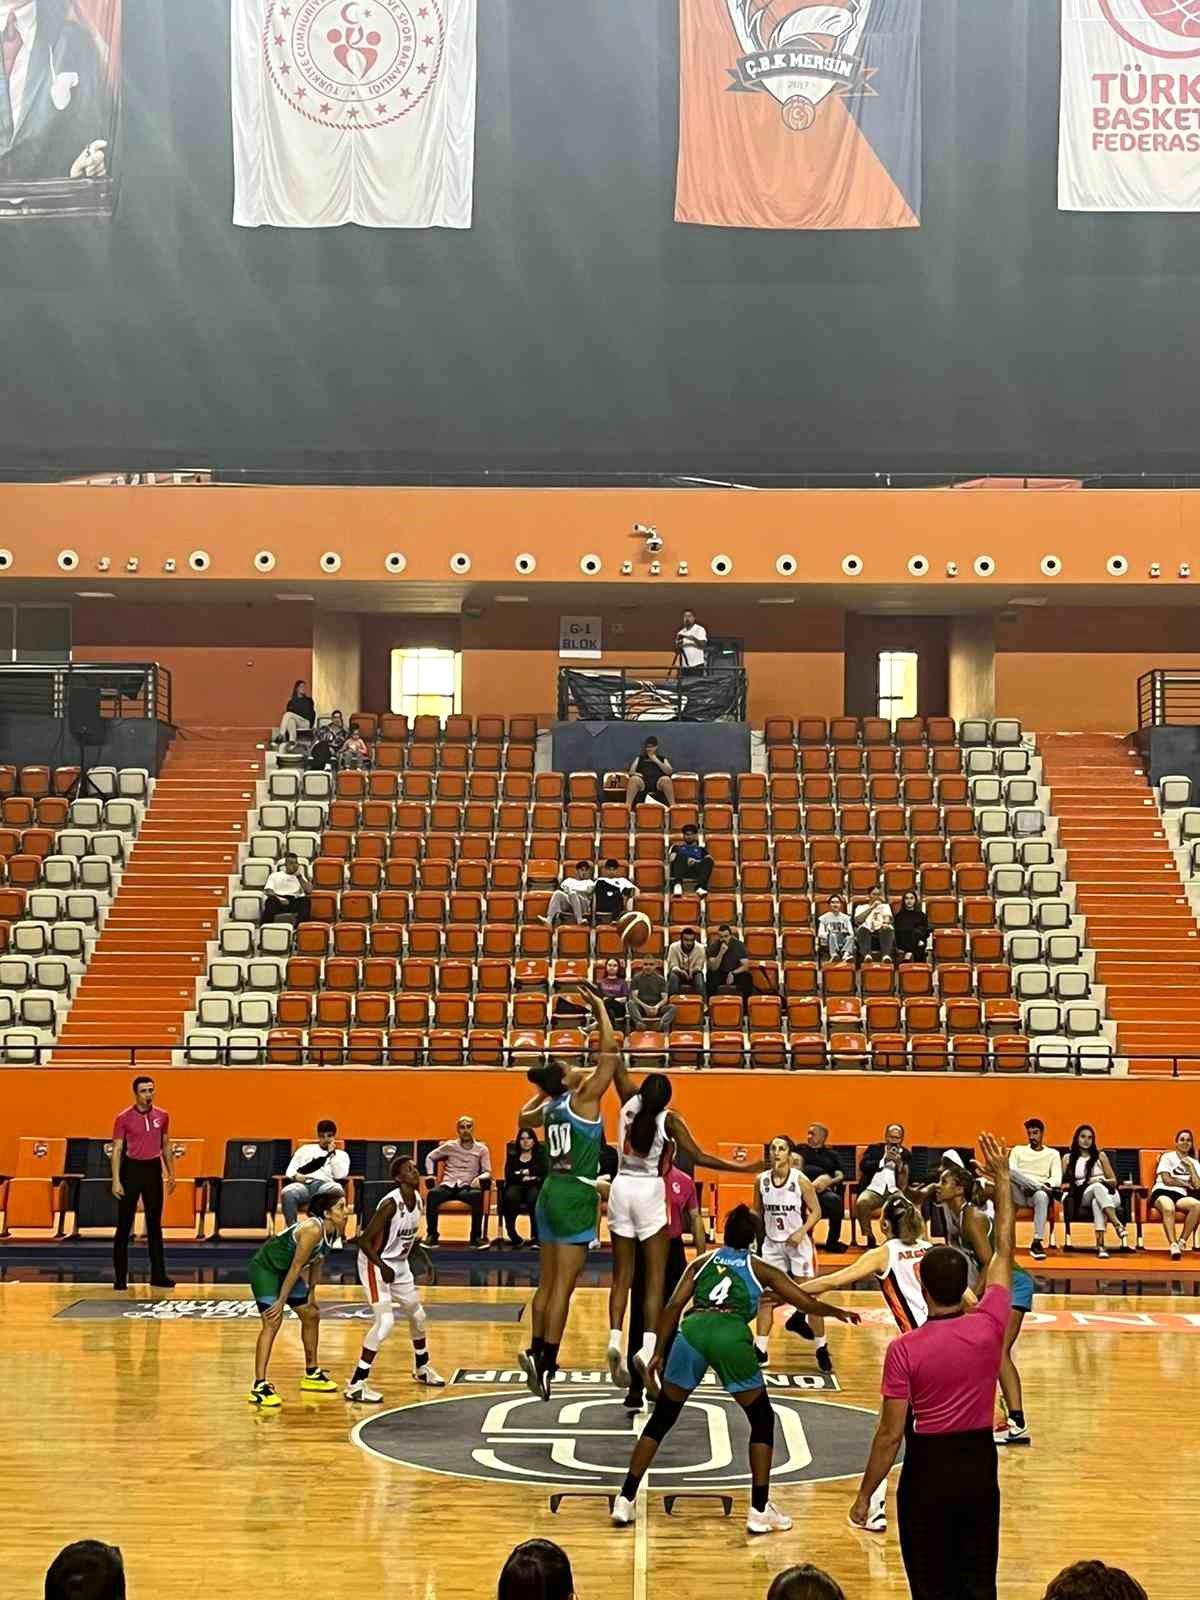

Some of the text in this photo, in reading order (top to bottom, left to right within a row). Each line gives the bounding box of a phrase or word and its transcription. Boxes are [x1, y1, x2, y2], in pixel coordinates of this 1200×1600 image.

[789, 52, 854, 77] MERSİN
[1092, 133, 1200, 152] FEDERAS
[562, 638, 600, 649] BLOK
[548, 1122, 571, 1157] 00
[775, 1217, 785, 1231] 3
[708, 1276, 732, 1305] 4
